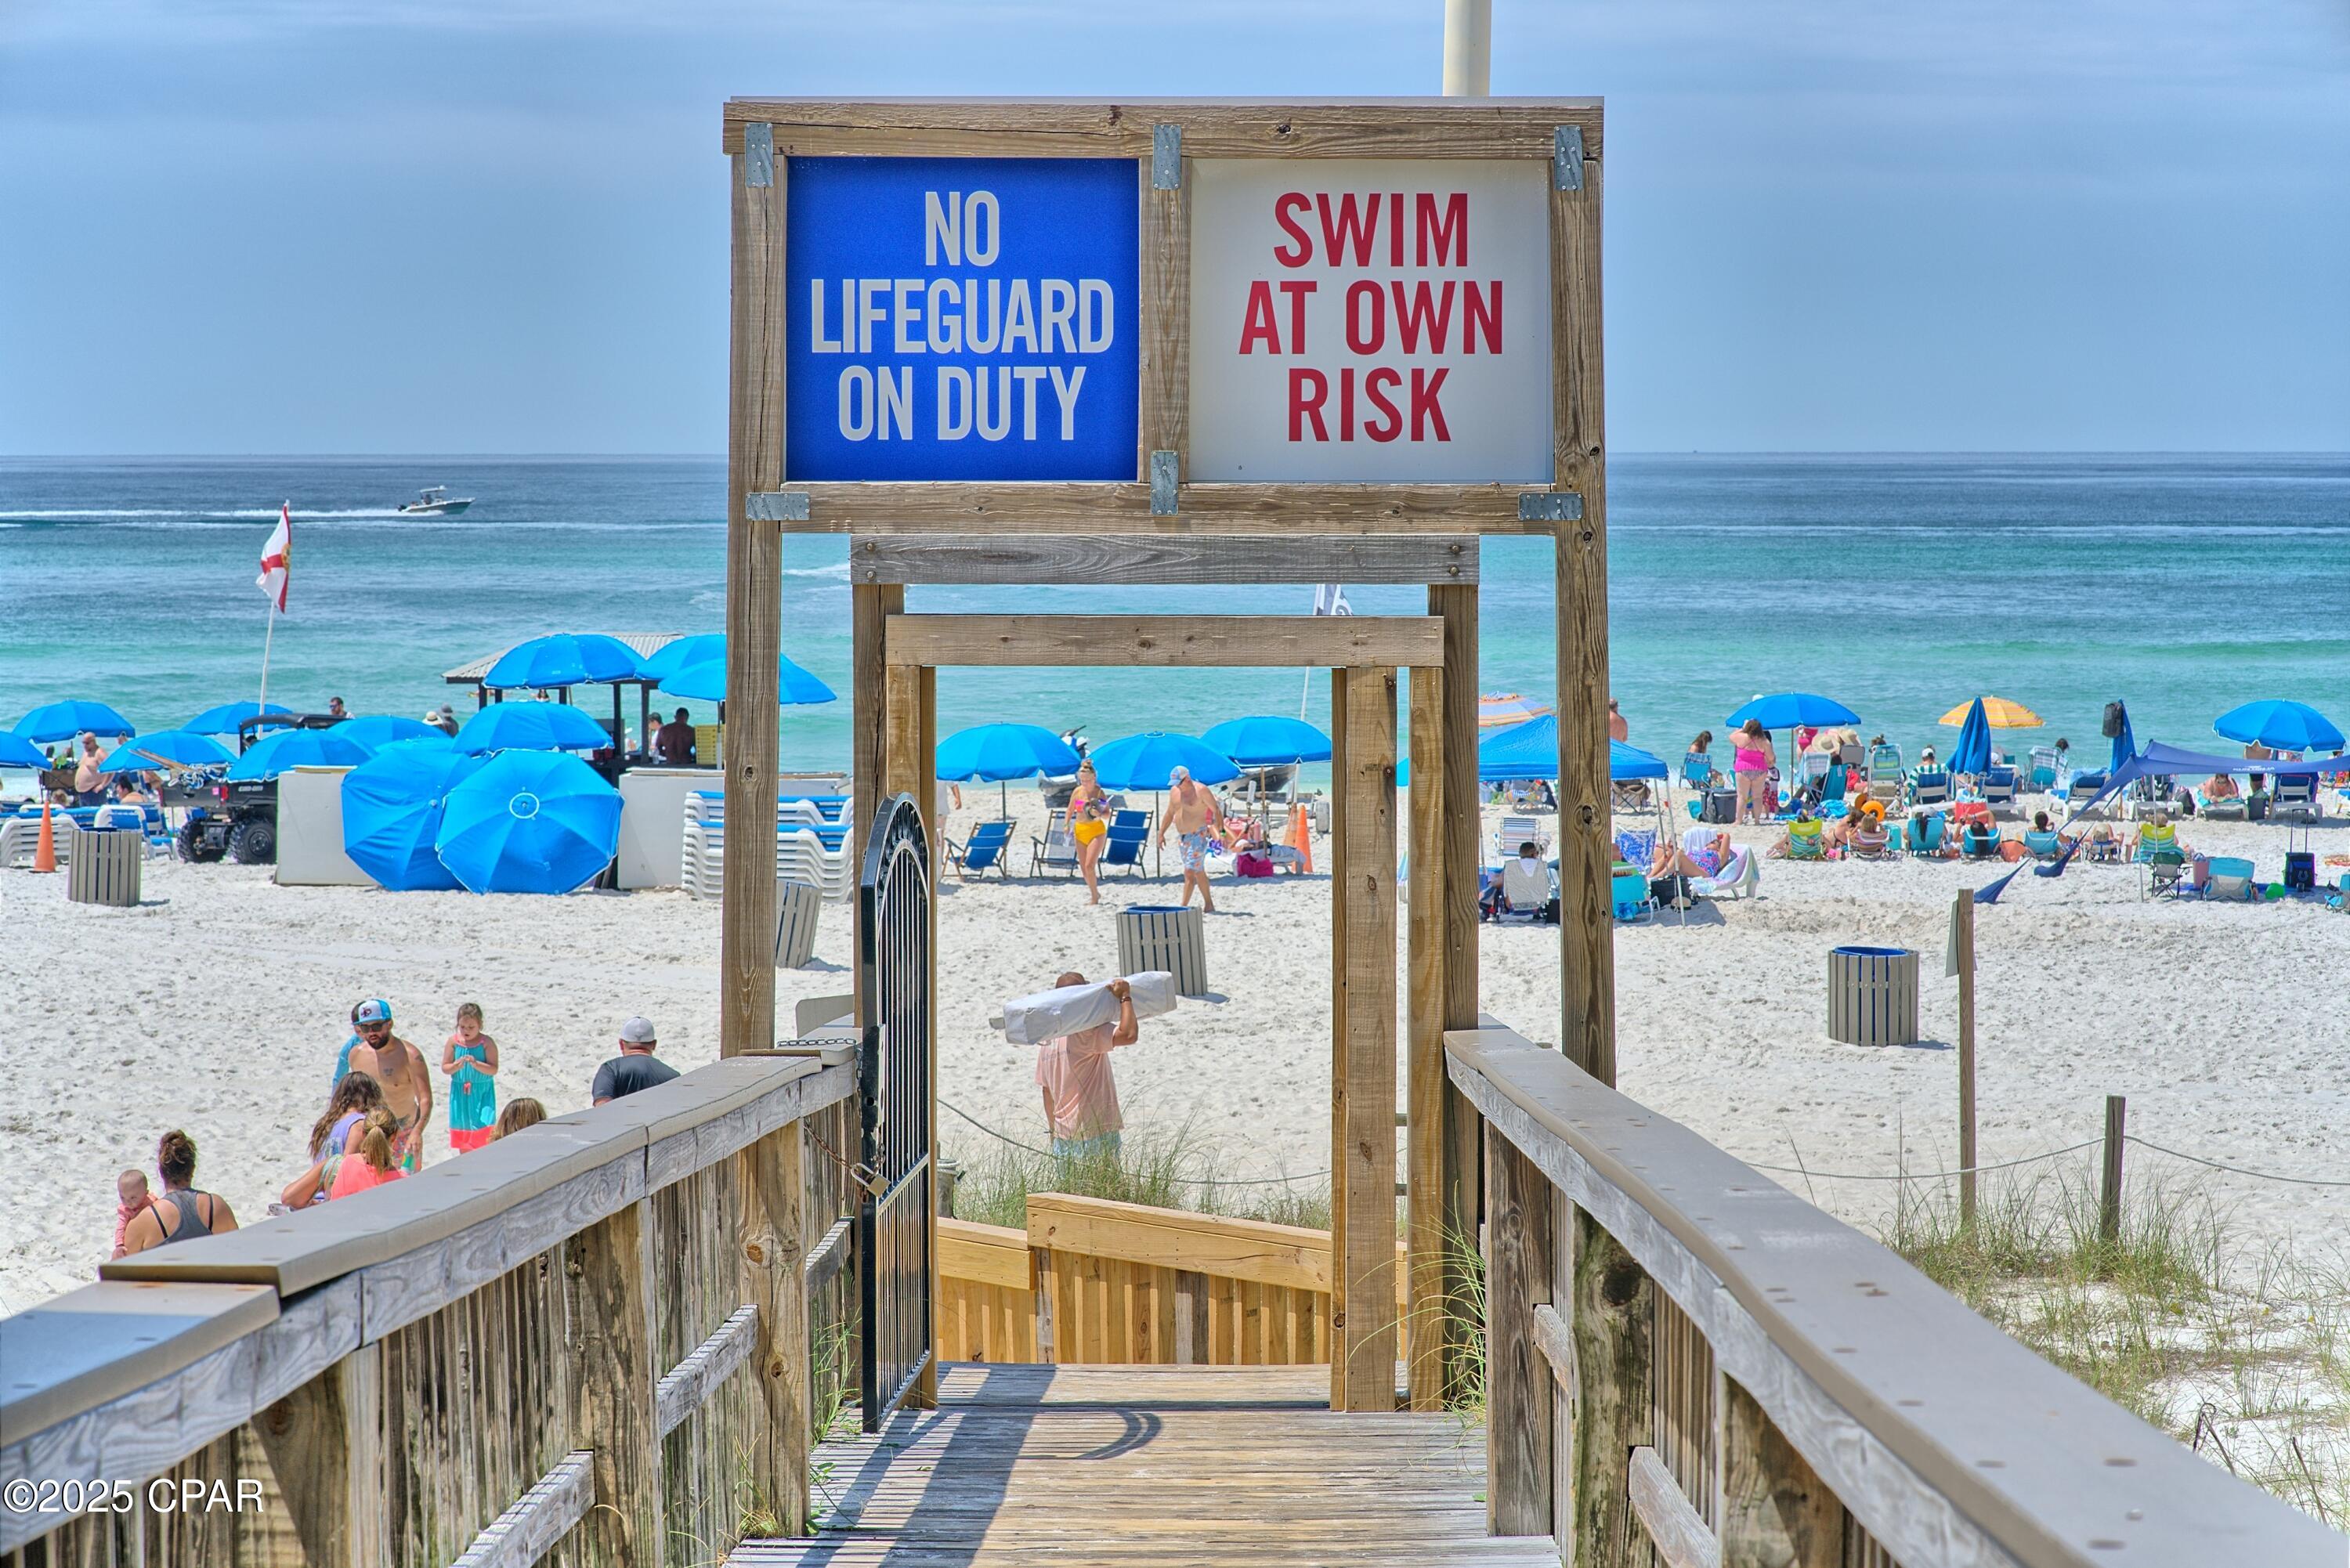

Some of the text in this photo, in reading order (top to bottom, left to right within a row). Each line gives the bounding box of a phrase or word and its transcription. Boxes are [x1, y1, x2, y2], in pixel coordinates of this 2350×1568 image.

[925, 190, 1000, 266] NO
[1274, 192, 1468, 268] SWIM
[812, 278, 1114, 354] LIFEGUARD
[1239, 280, 1502, 355] AT OWN
[839, 366, 1086, 441] ON DUTY
[1289, 367, 1451, 443] RISK
